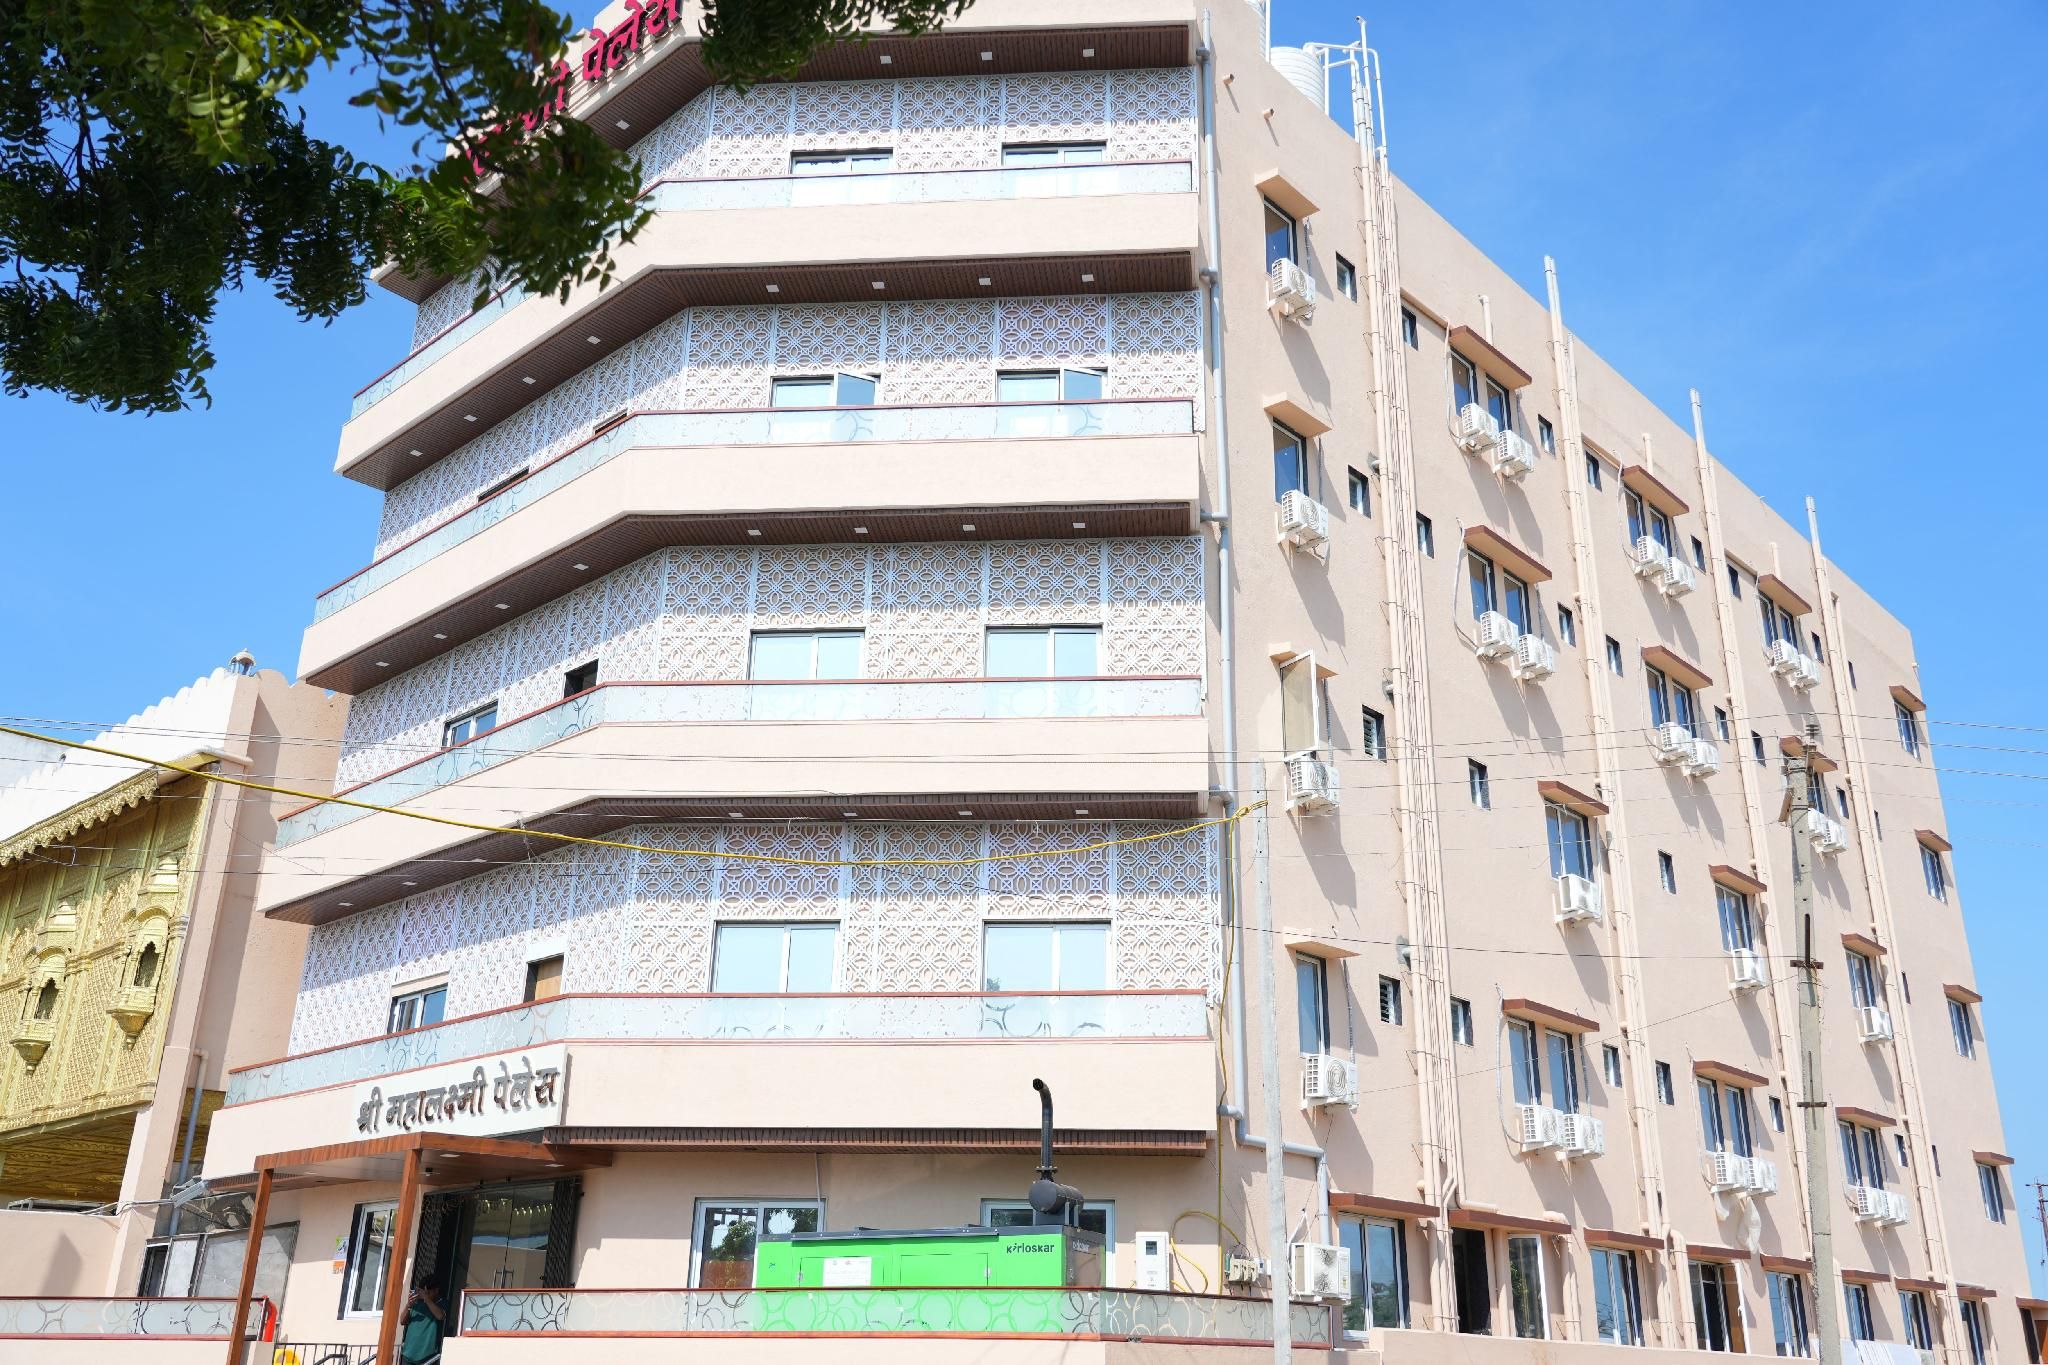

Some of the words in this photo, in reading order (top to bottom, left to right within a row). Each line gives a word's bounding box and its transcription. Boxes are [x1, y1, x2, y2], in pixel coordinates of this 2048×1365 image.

[357, 1086, 382, 1133] श्री
[386, 1066, 487, 1130] महालक्ष्मी
[494, 1056, 560, 1112] पेलेस
